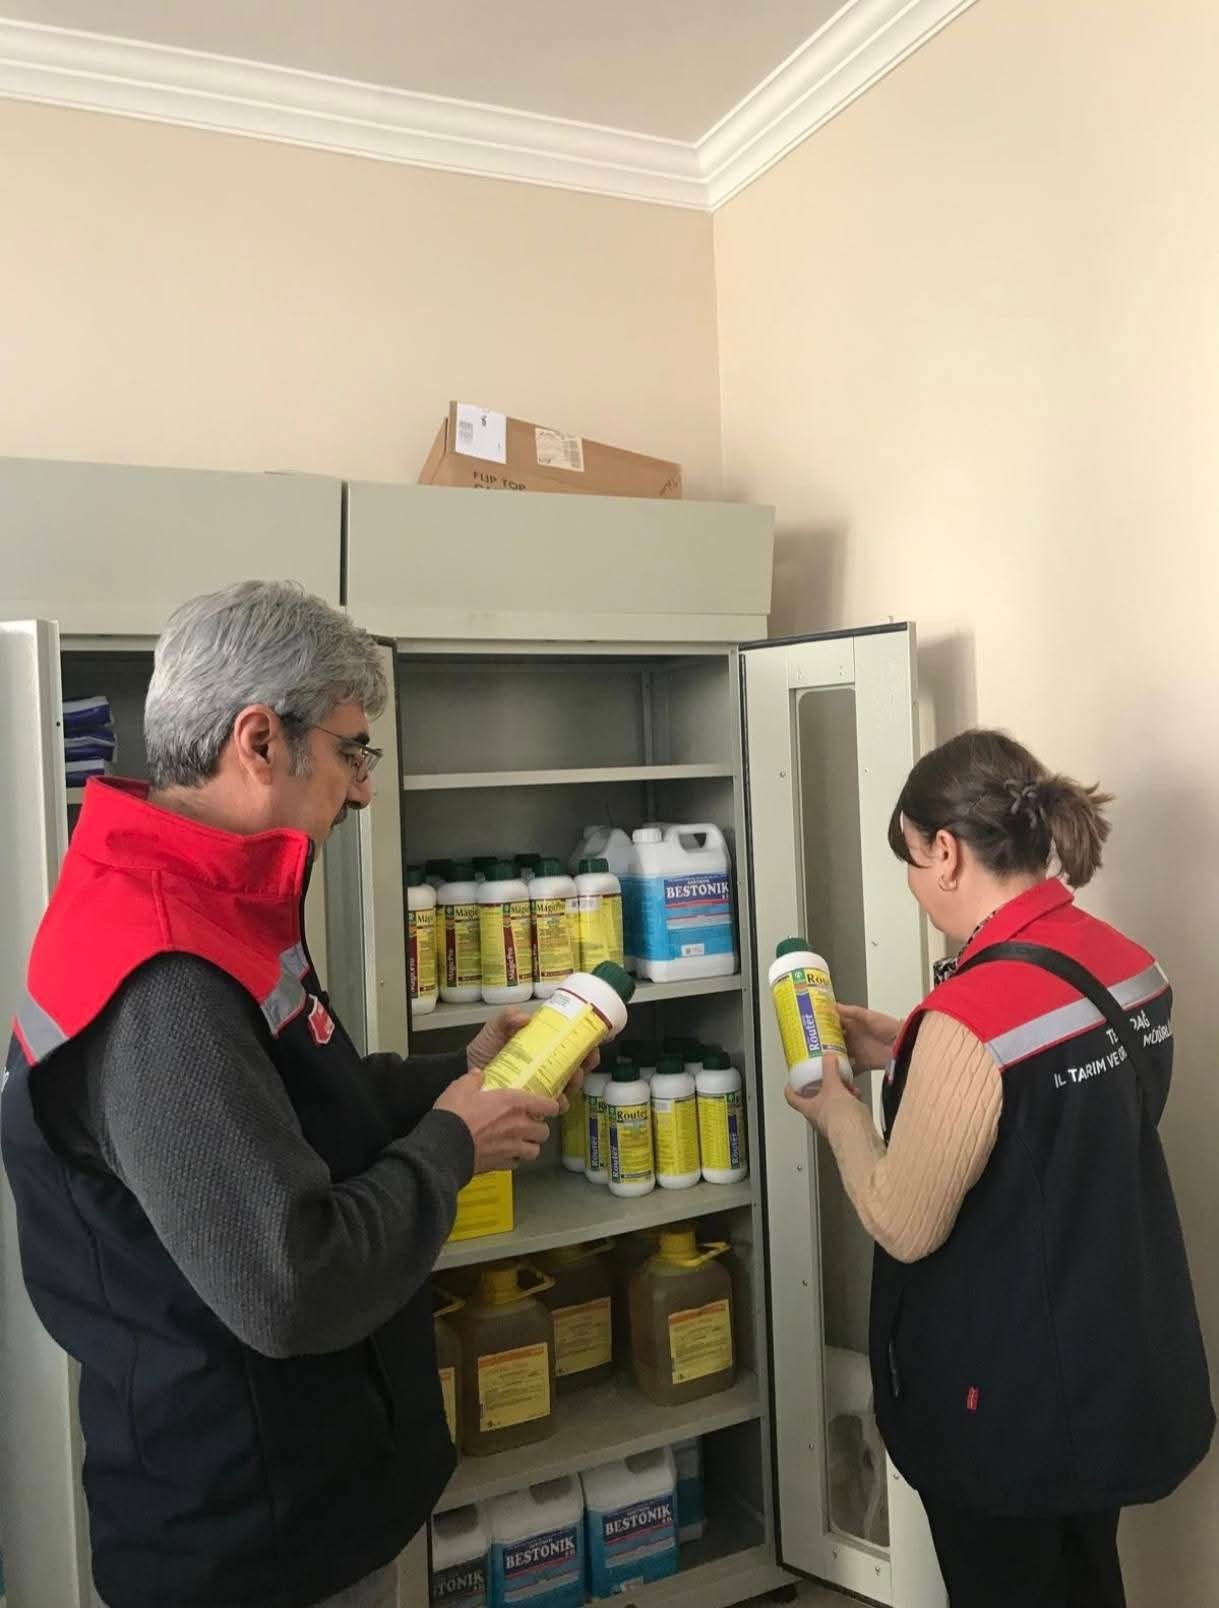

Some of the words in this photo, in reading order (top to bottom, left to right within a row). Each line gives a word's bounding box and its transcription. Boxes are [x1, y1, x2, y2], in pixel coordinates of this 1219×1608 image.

[473, 471, 497, 485] FLIP
[500, 478, 527, 491] TOP
[666, 882, 729, 899] BESTONIK
[803, 1014, 820, 1051] Router
[1067, 1058, 1107, 1083] TARIM
[1106, 1051, 1120, 1069] VE
[611, 1145, 620, 1178] Router
[605, 1503, 671, 1537] BESTONIK
[505, 1535, 576, 1569] BESTONIK
